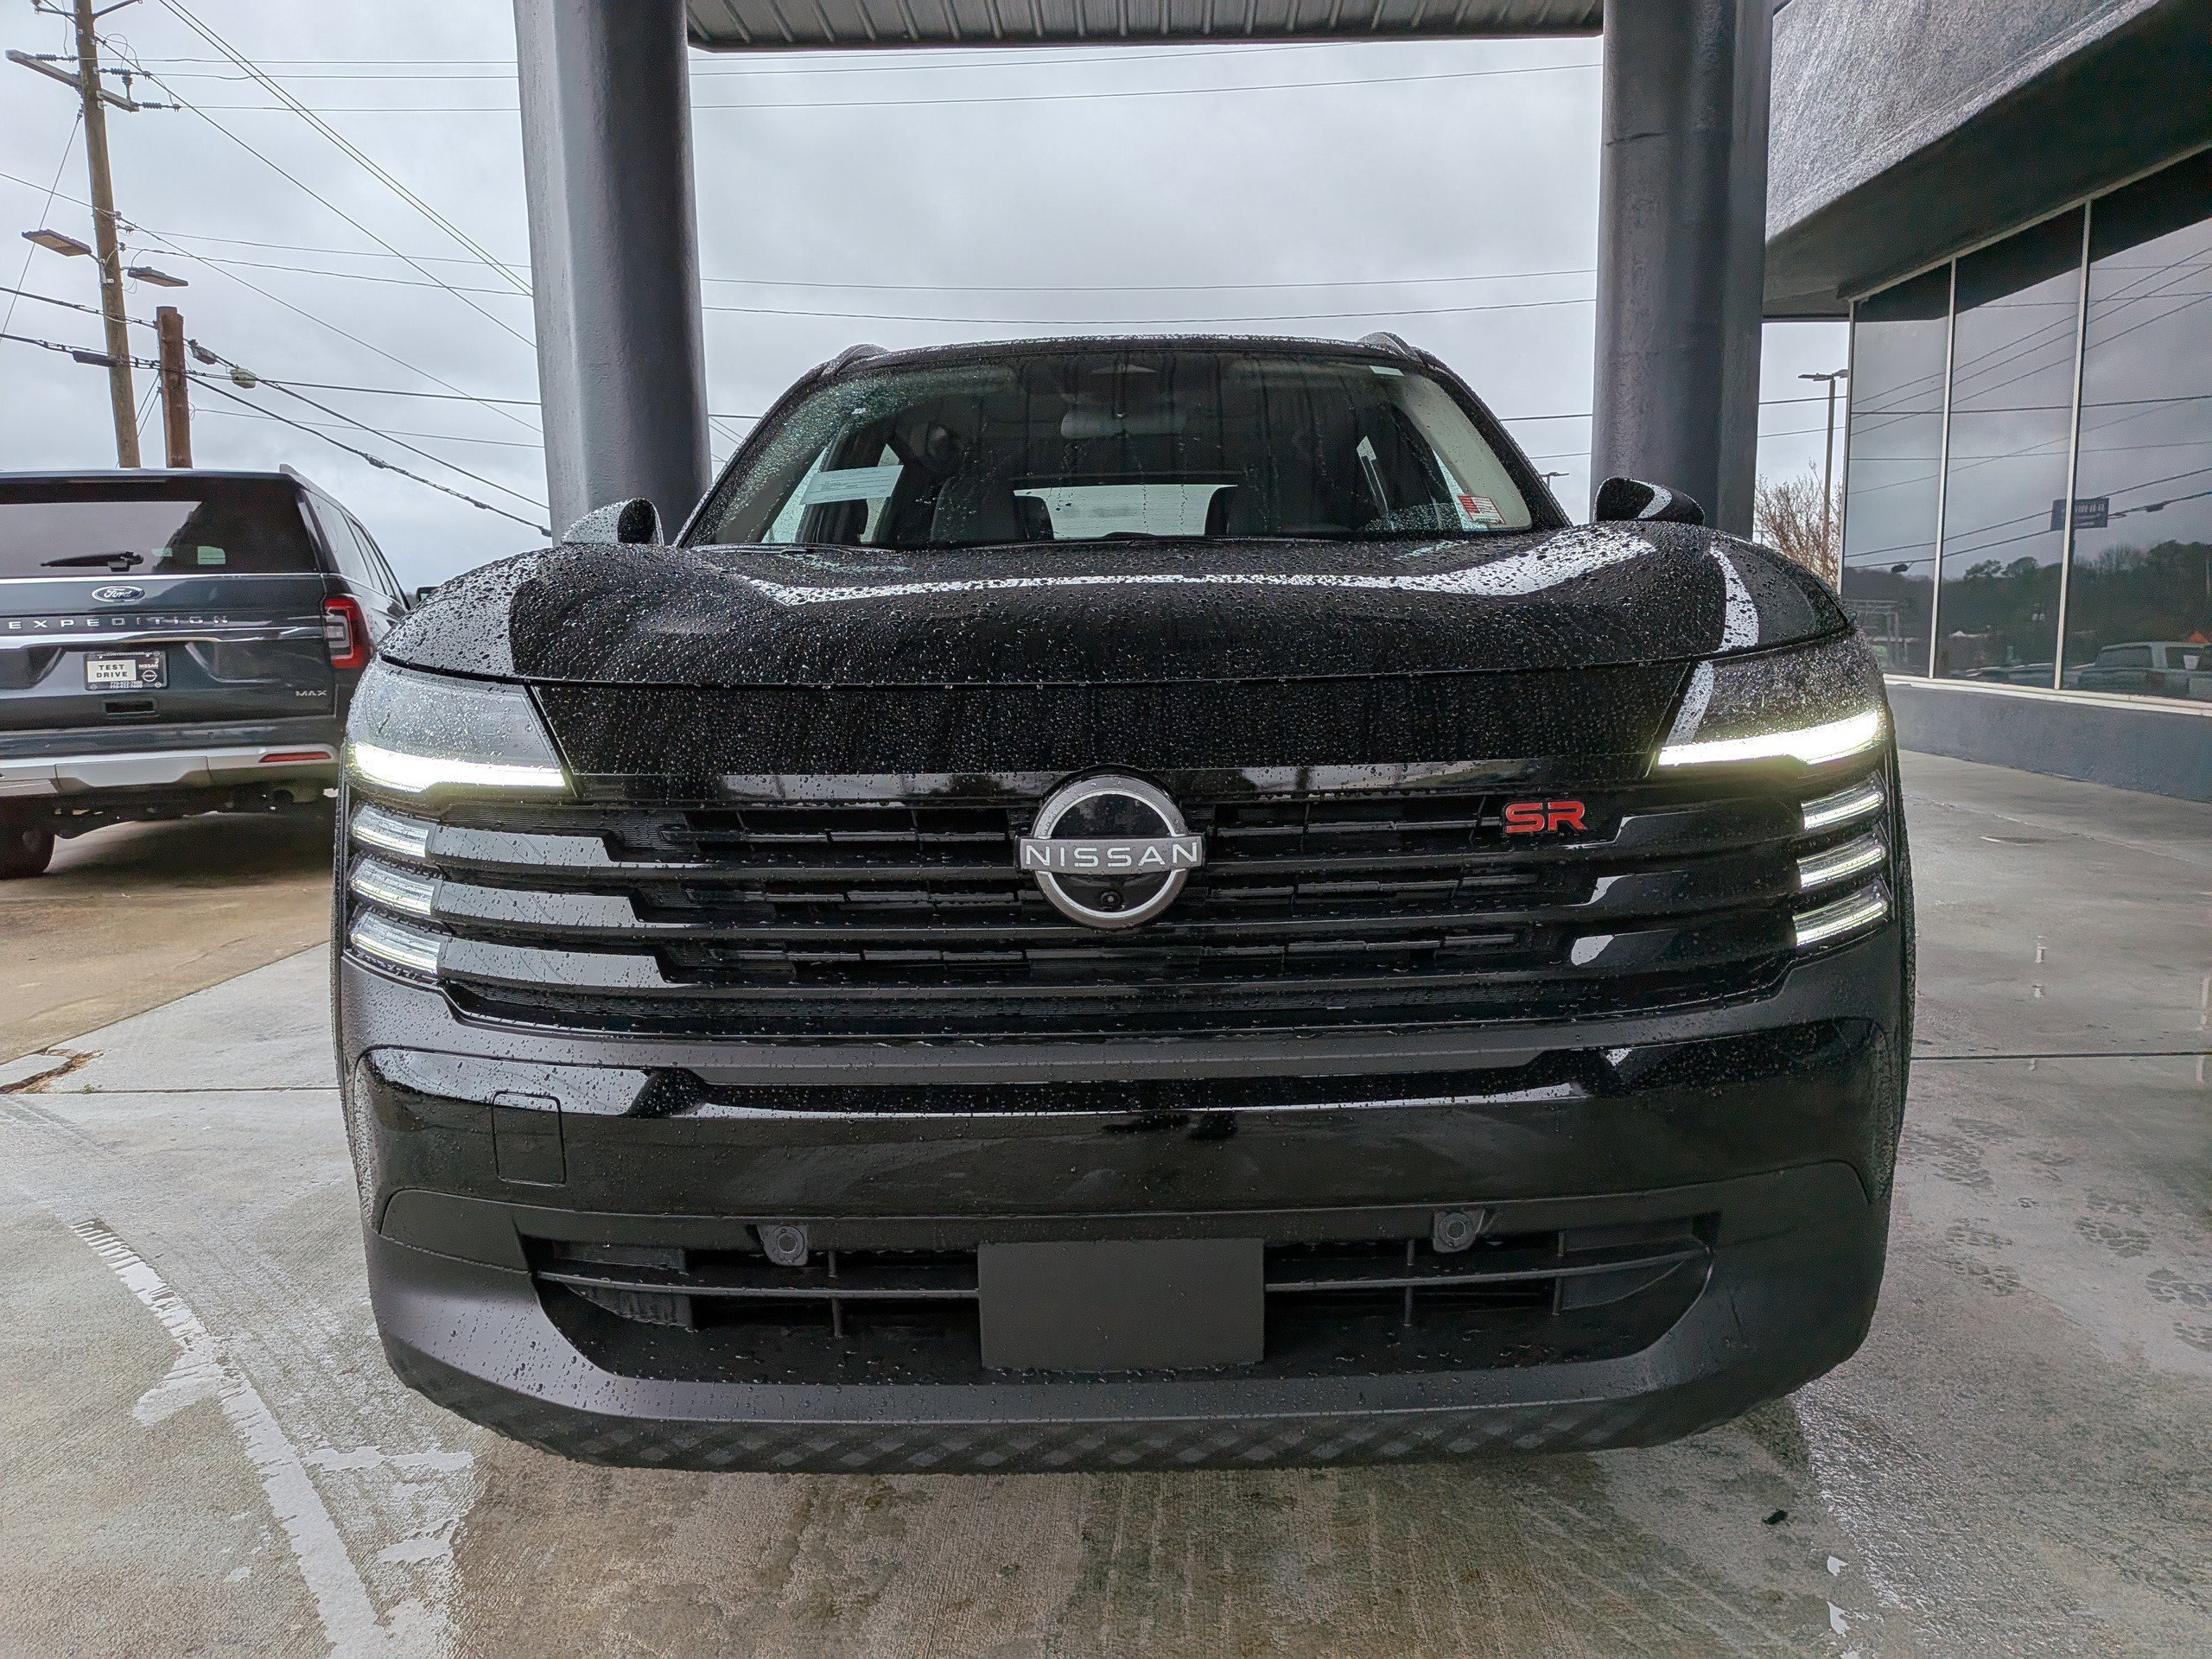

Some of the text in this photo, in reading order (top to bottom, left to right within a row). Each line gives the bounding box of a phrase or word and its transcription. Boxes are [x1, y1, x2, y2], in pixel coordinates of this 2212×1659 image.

[104, 588, 133, 598] Ford
[9, 615, 228, 630] EXPEDITION
[1505, 800, 1587, 833] SR
[1026, 842, 1198, 867] NISSAN
